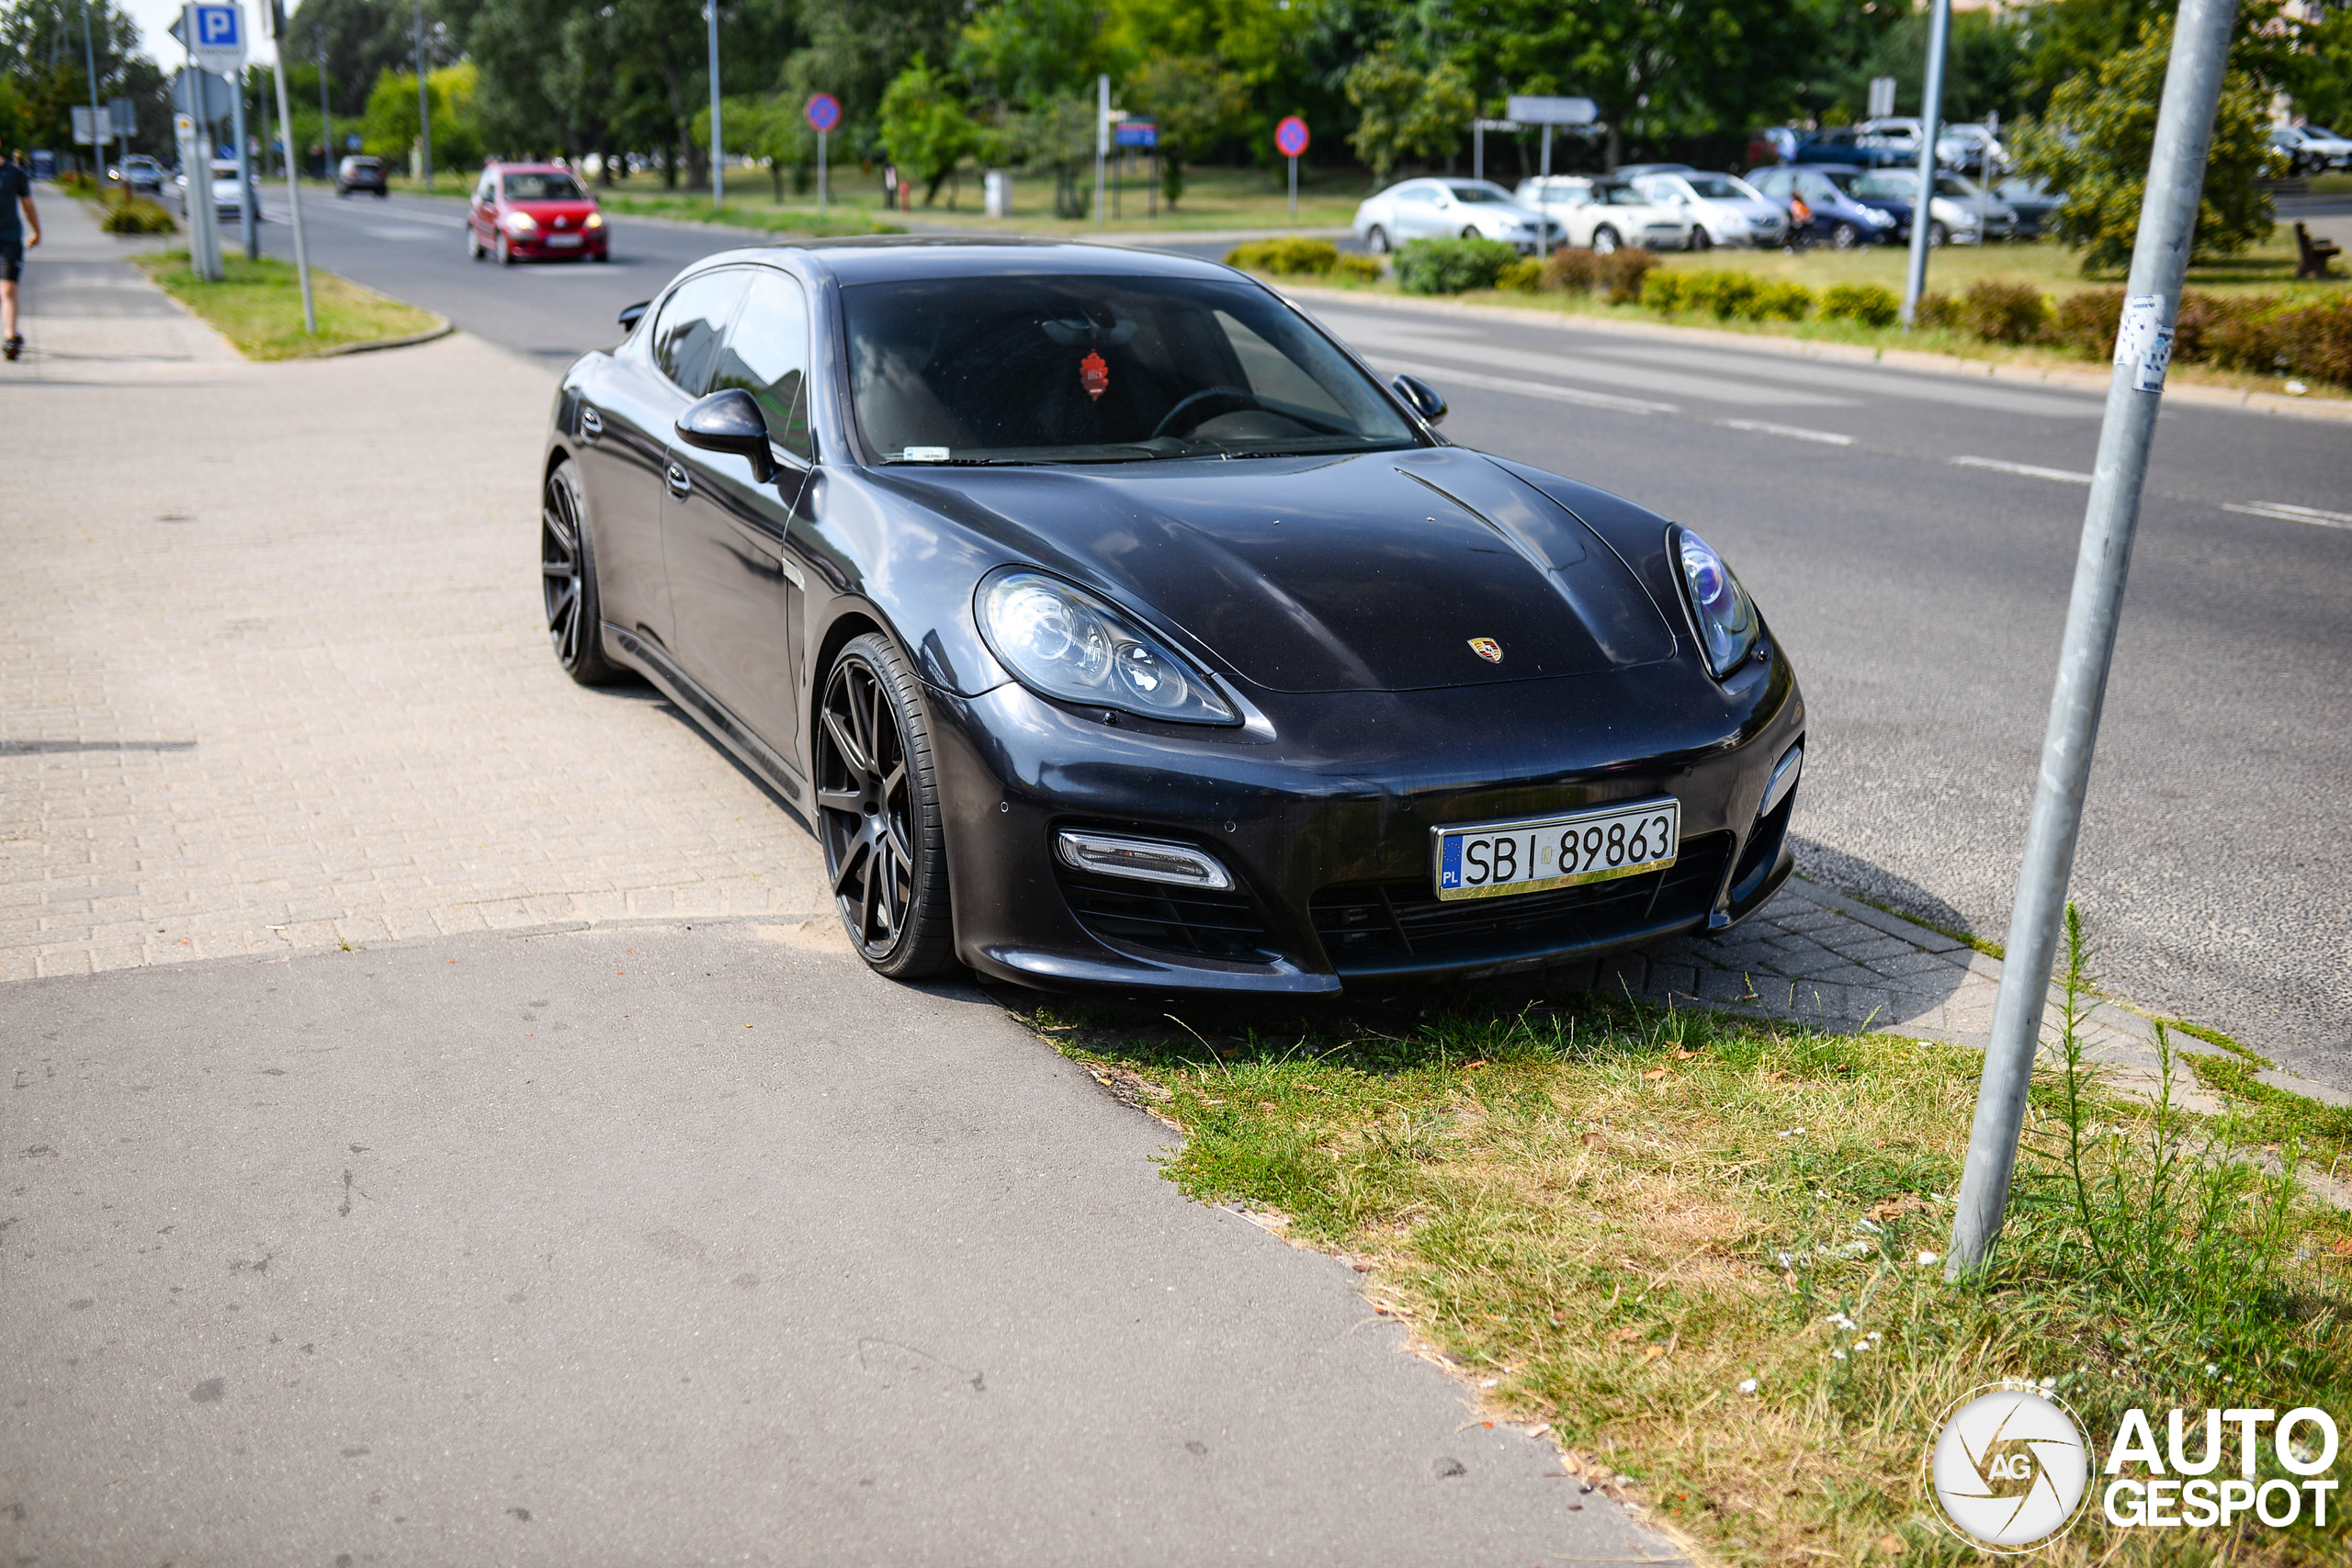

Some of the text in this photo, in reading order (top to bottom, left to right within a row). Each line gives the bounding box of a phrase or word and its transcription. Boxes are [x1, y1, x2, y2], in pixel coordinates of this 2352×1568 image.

[206, 10, 231, 42] P
[1465, 816, 1669, 885] SBI 89863
[1443, 871, 1458, 884] PL
